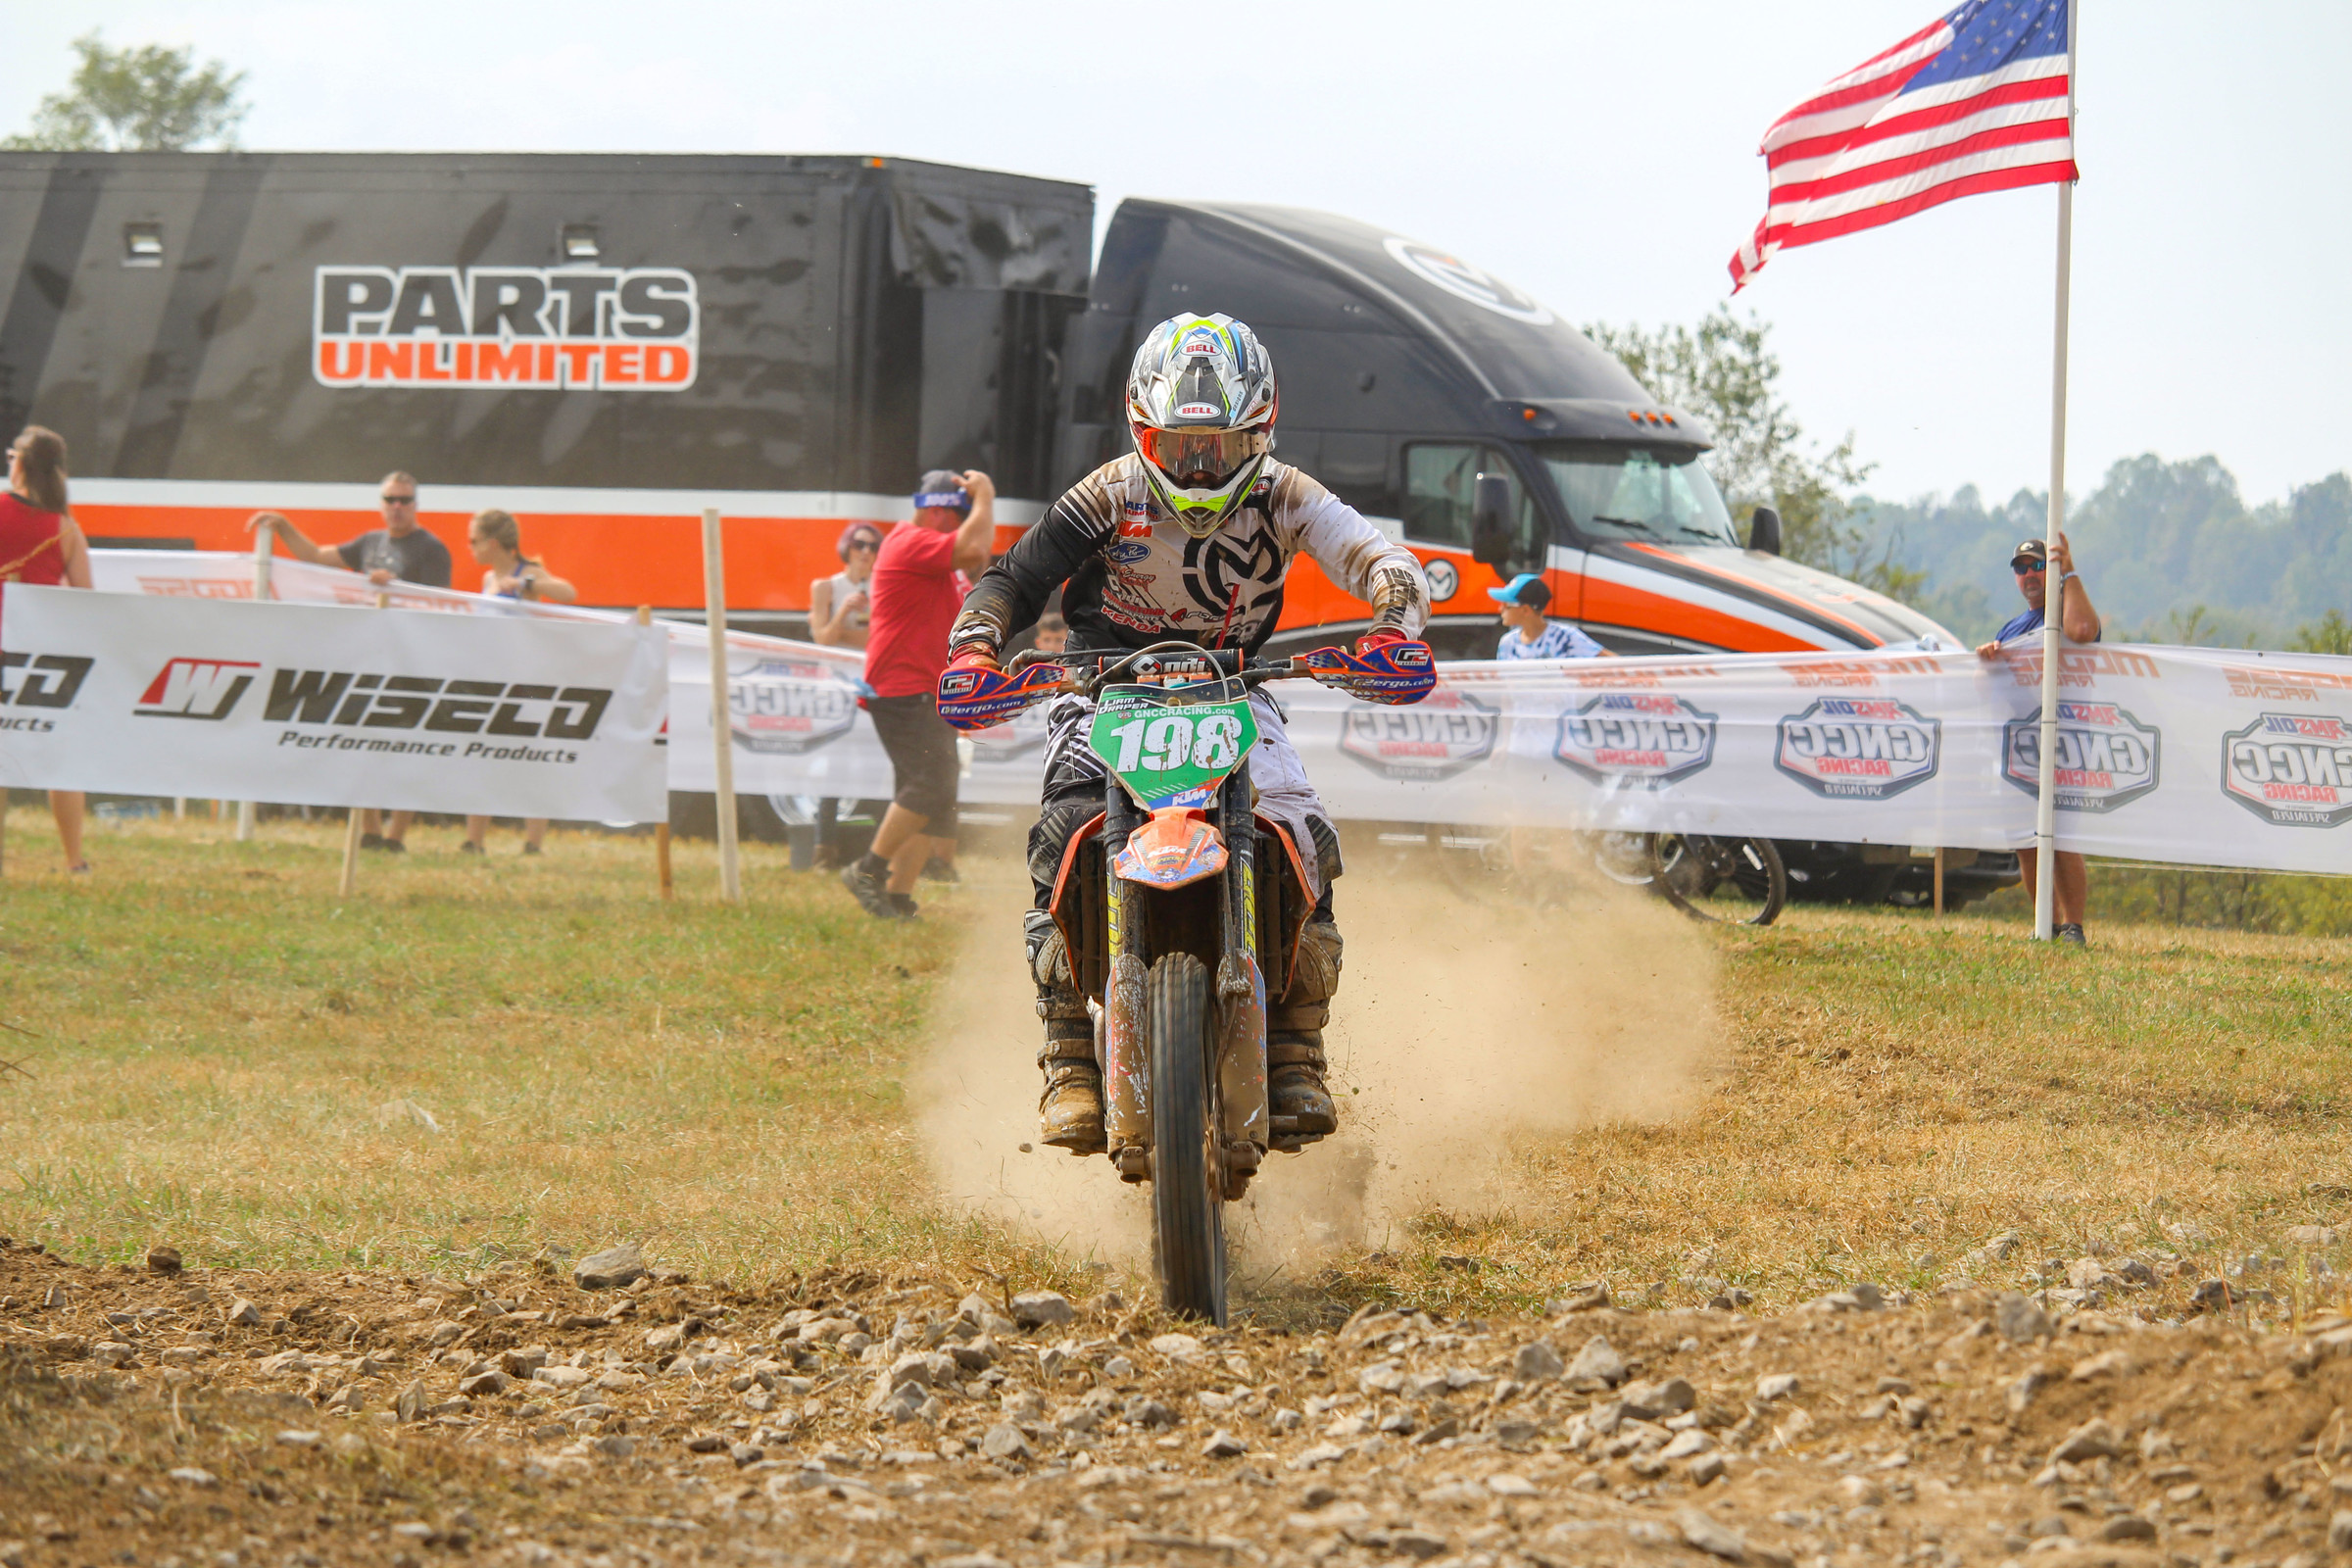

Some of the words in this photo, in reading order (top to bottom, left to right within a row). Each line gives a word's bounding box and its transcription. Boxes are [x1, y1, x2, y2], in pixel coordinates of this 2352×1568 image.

[318, 270, 694, 339] PARTS
[1186, 344, 1216, 354] BELL
[319, 341, 691, 384] UNLIMITED
[1182, 406, 1214, 415] BELL
[1102, 606, 1160, 633] KENDA
[1397, 649, 1429, 662] G2
[943, 674, 974, 690] G2
[1098, 703, 1150, 714] DRAPER
[1104, 697, 1136, 707] LIAM
[277, 731, 457, 757] Performance
[463, 741, 579, 763] Products
[1110, 715, 1243, 773] 198
[1172, 787, 1207, 808] KTM
